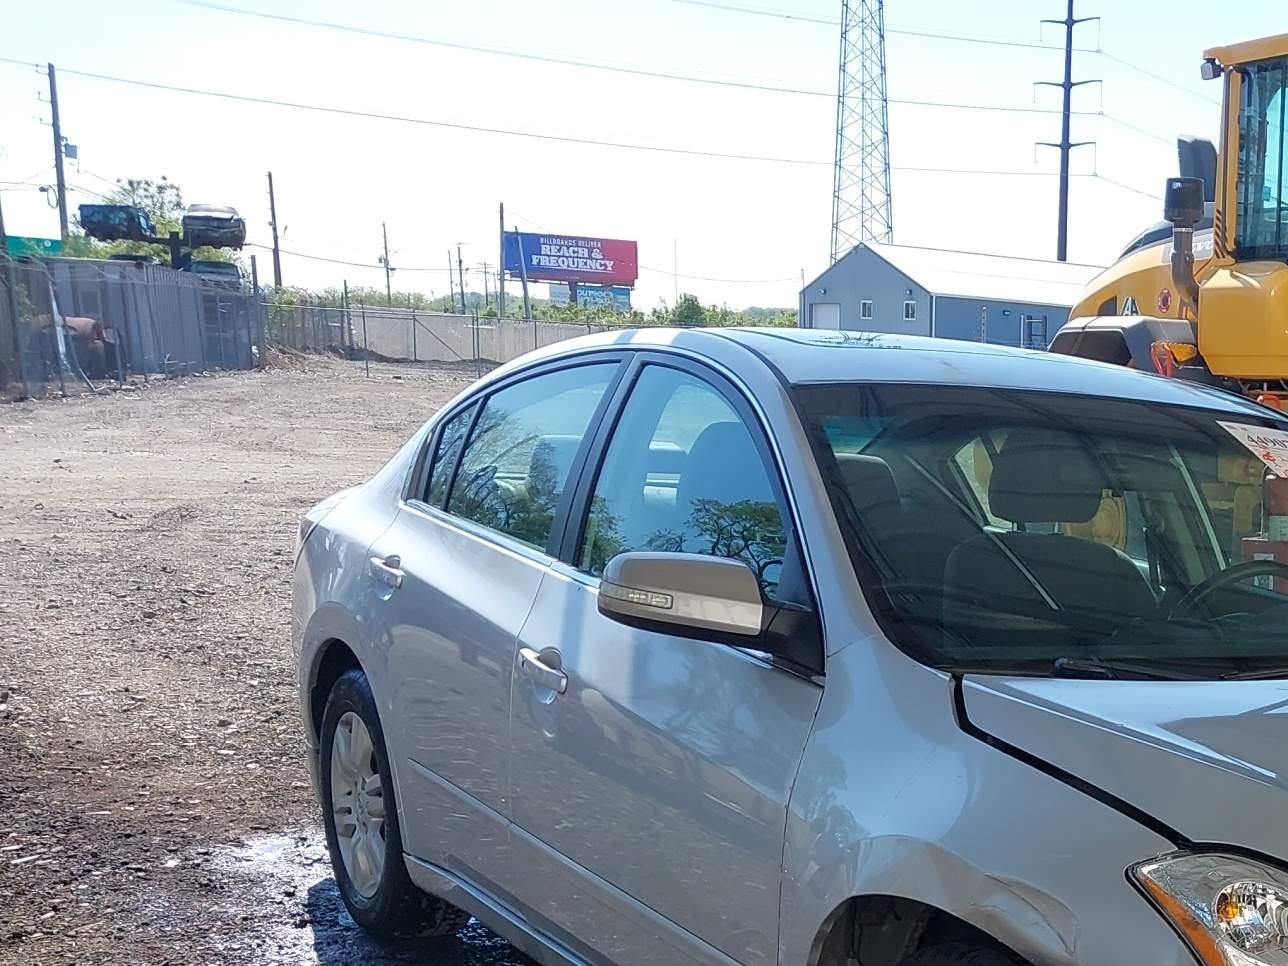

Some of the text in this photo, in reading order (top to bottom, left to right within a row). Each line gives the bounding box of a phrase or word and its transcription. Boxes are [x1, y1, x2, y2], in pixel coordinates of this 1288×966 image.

[541, 245, 603, 259] REACH &
[531, 255, 614, 271] FREQUENCY
